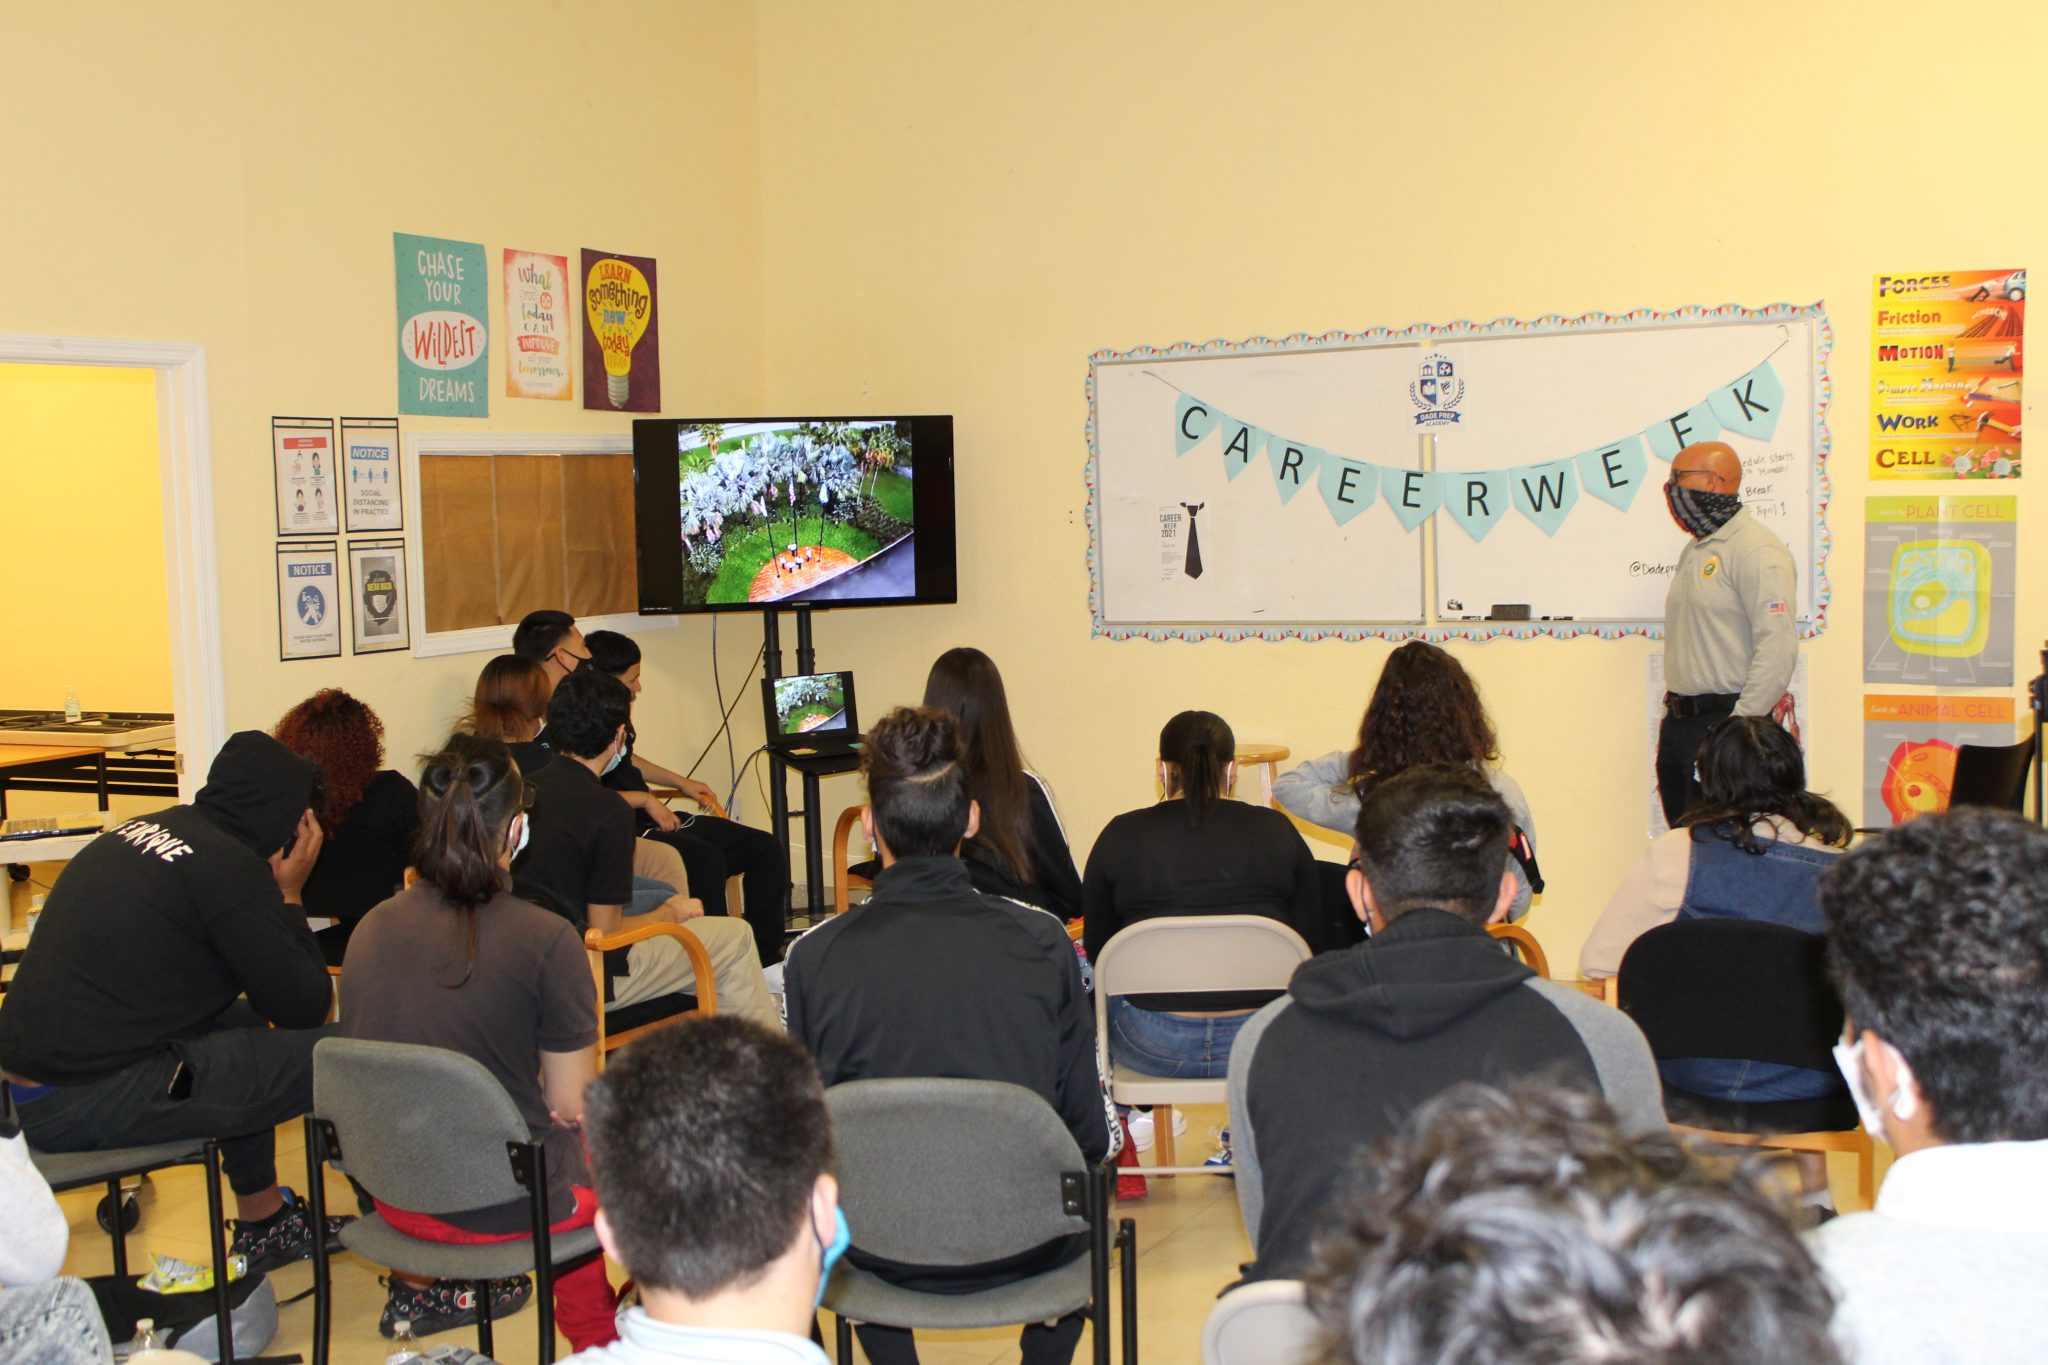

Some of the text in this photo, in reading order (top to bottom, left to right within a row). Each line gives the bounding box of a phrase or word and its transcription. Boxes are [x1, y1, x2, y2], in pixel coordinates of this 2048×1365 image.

[417, 250, 465, 280] CHASE
[599, 263, 632, 284] LEARN
[518, 263, 553, 291] What
[424, 278, 461, 305] YOUR
[1880, 275, 1951, 298] FORCES
[589, 281, 649, 320] something
[521, 302, 554, 331] today
[603, 308, 627, 325] new
[1878, 309, 1941, 326] Friction
[524, 322, 549, 334] CAN
[522, 337, 557, 352] IMPROVE
[602, 331, 630, 356] today
[1878, 344, 1944, 362] MOTION
[419, 377, 475, 403] DREAMS
[1420, 412, 1455, 422] DADE PREP
[1877, 412, 1939, 432] WORK
[352, 448, 388, 459] NOTICE
[1876, 448, 1936, 468] CELL
[360, 489, 381, 497] SOCIAL
[353, 508, 390, 516] IN PRACTICE
[1160, 513, 1182, 523] CAREER
[1906, 504, 1958, 519] PLANT
[1963, 504, 2005, 519] CELL
[1161, 529, 1176, 538] 2021
[293, 564, 326, 576] NOTICE
[1897, 703, 1960, 718] ANIMAL
[1964, 703, 2006, 719] CELL
